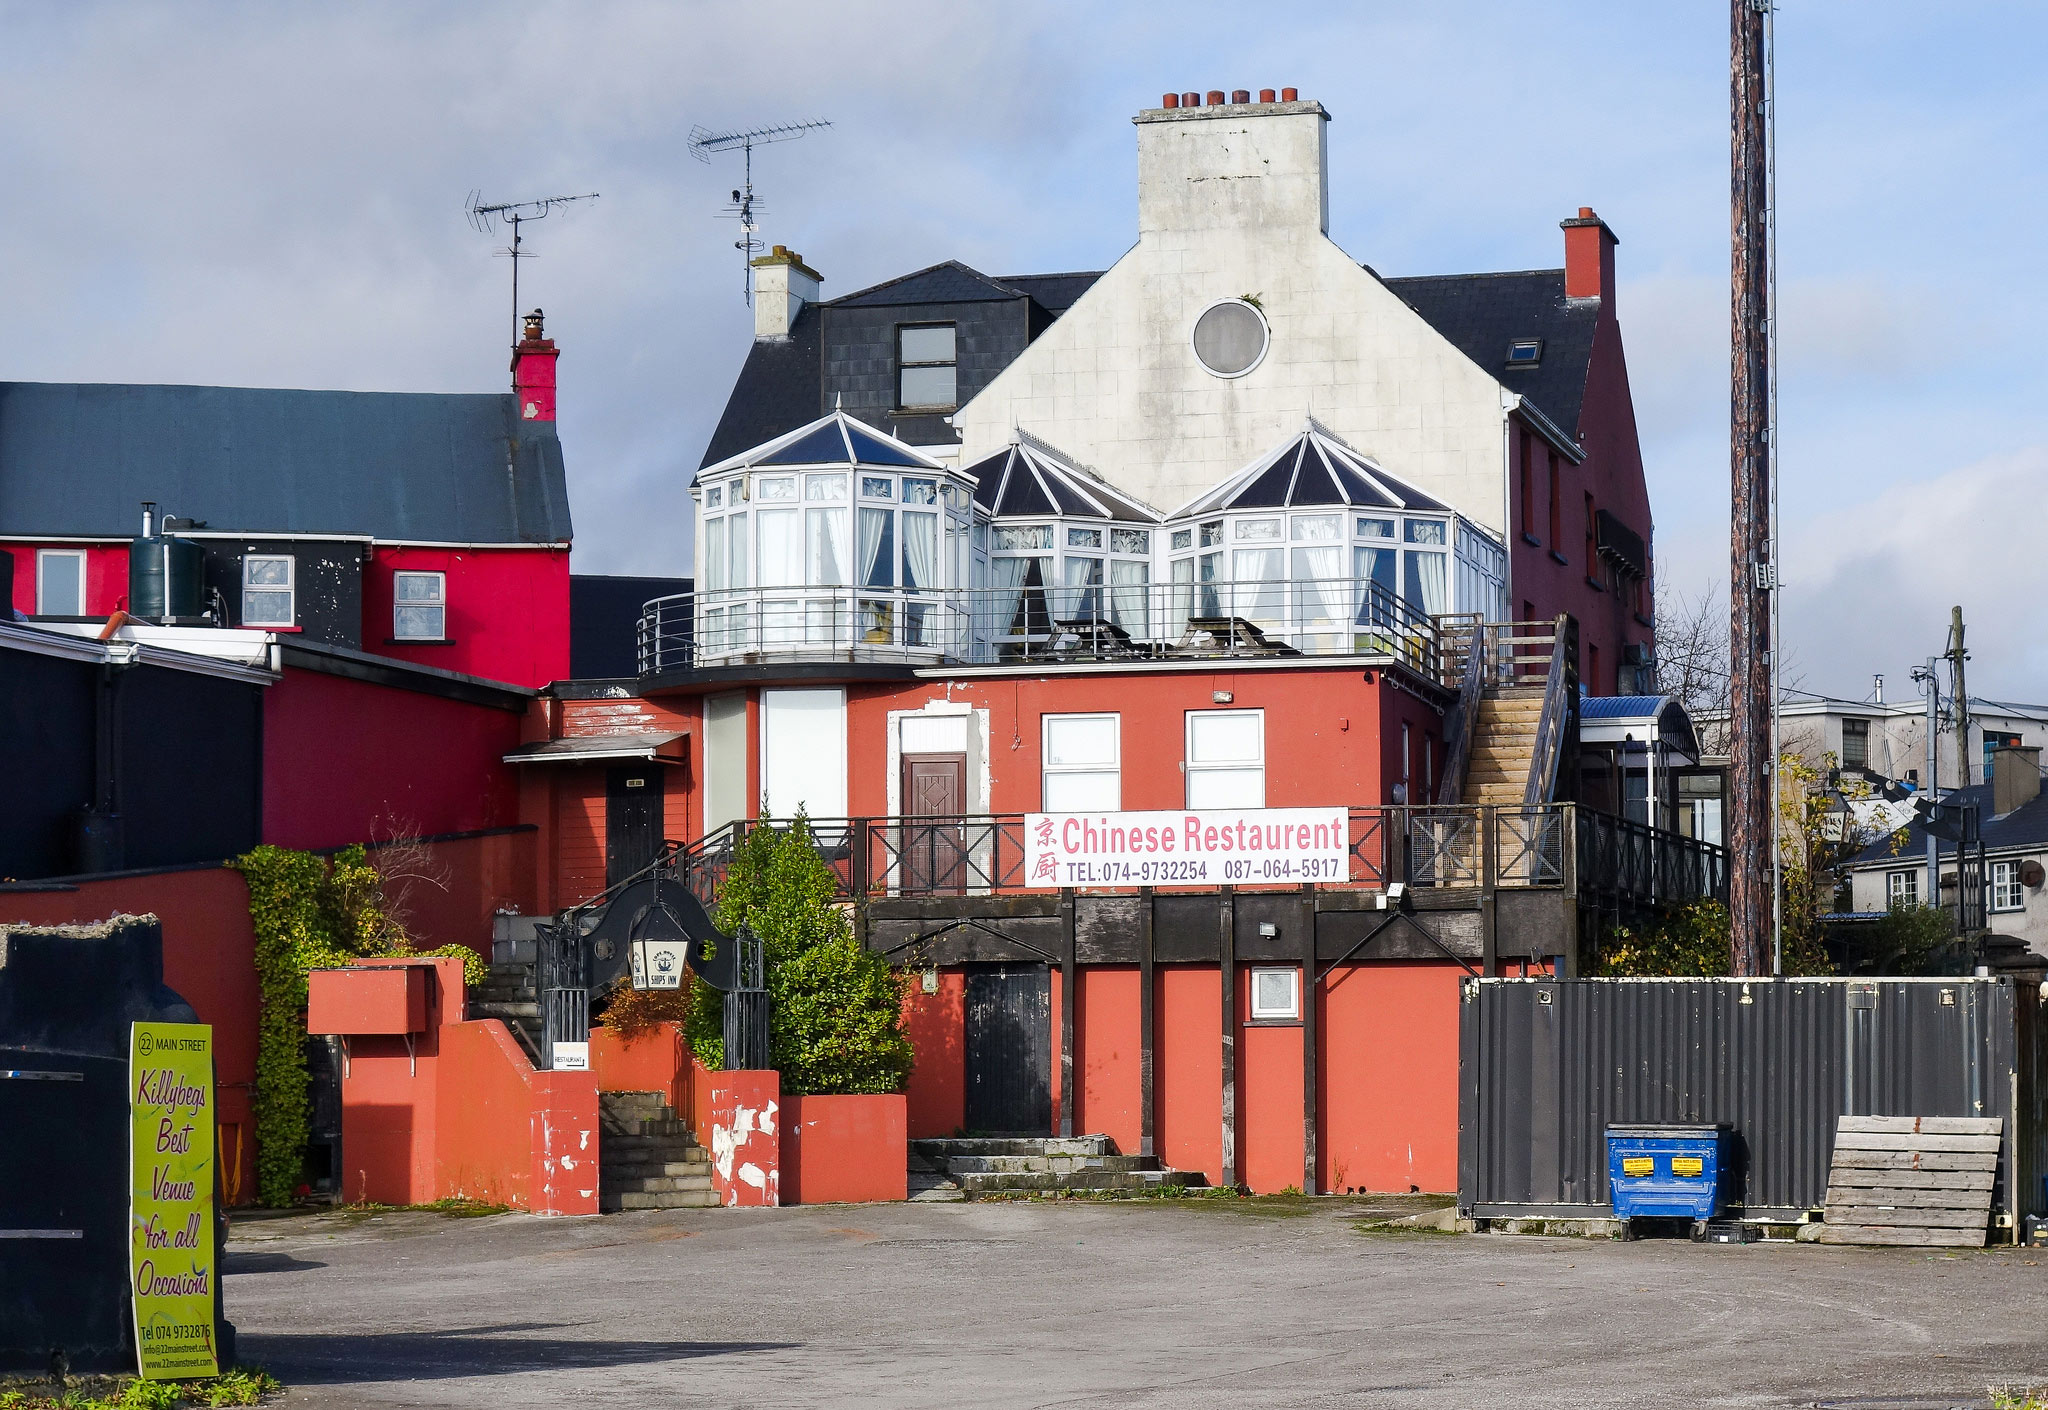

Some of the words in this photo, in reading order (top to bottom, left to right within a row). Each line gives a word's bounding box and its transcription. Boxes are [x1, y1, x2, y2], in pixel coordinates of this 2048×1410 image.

[1062, 817, 1175, 854] Chinese
[1184, 817, 1342, 852] Restaurent
[1066, 861, 1208, 882] TEL:074-9732254
[1224, 858, 1339, 879] 087-064-5917
[651, 975, 666, 985] SHIPS
[667, 975, 677, 985] INN
[141, 1038, 151, 1050] 22
[155, 1038, 178, 1051] MAIN
[179, 1039, 207, 1052] STREET
[137, 1068, 206, 1117] Killybegs
[156, 1117, 195, 1154] Best
[152, 1163, 195, 1201] Venue
[145, 1213, 169, 1249] for
[174, 1212, 201, 1249] all
[137, 1259, 208, 1297] Occasions
[140, 1326, 154, 1340] Tel
[155, 1326, 171, 1340] 074
[173, 1324, 211, 1339] 9732876
[145, 1358, 213, 1369] www.22mainstreet.com
